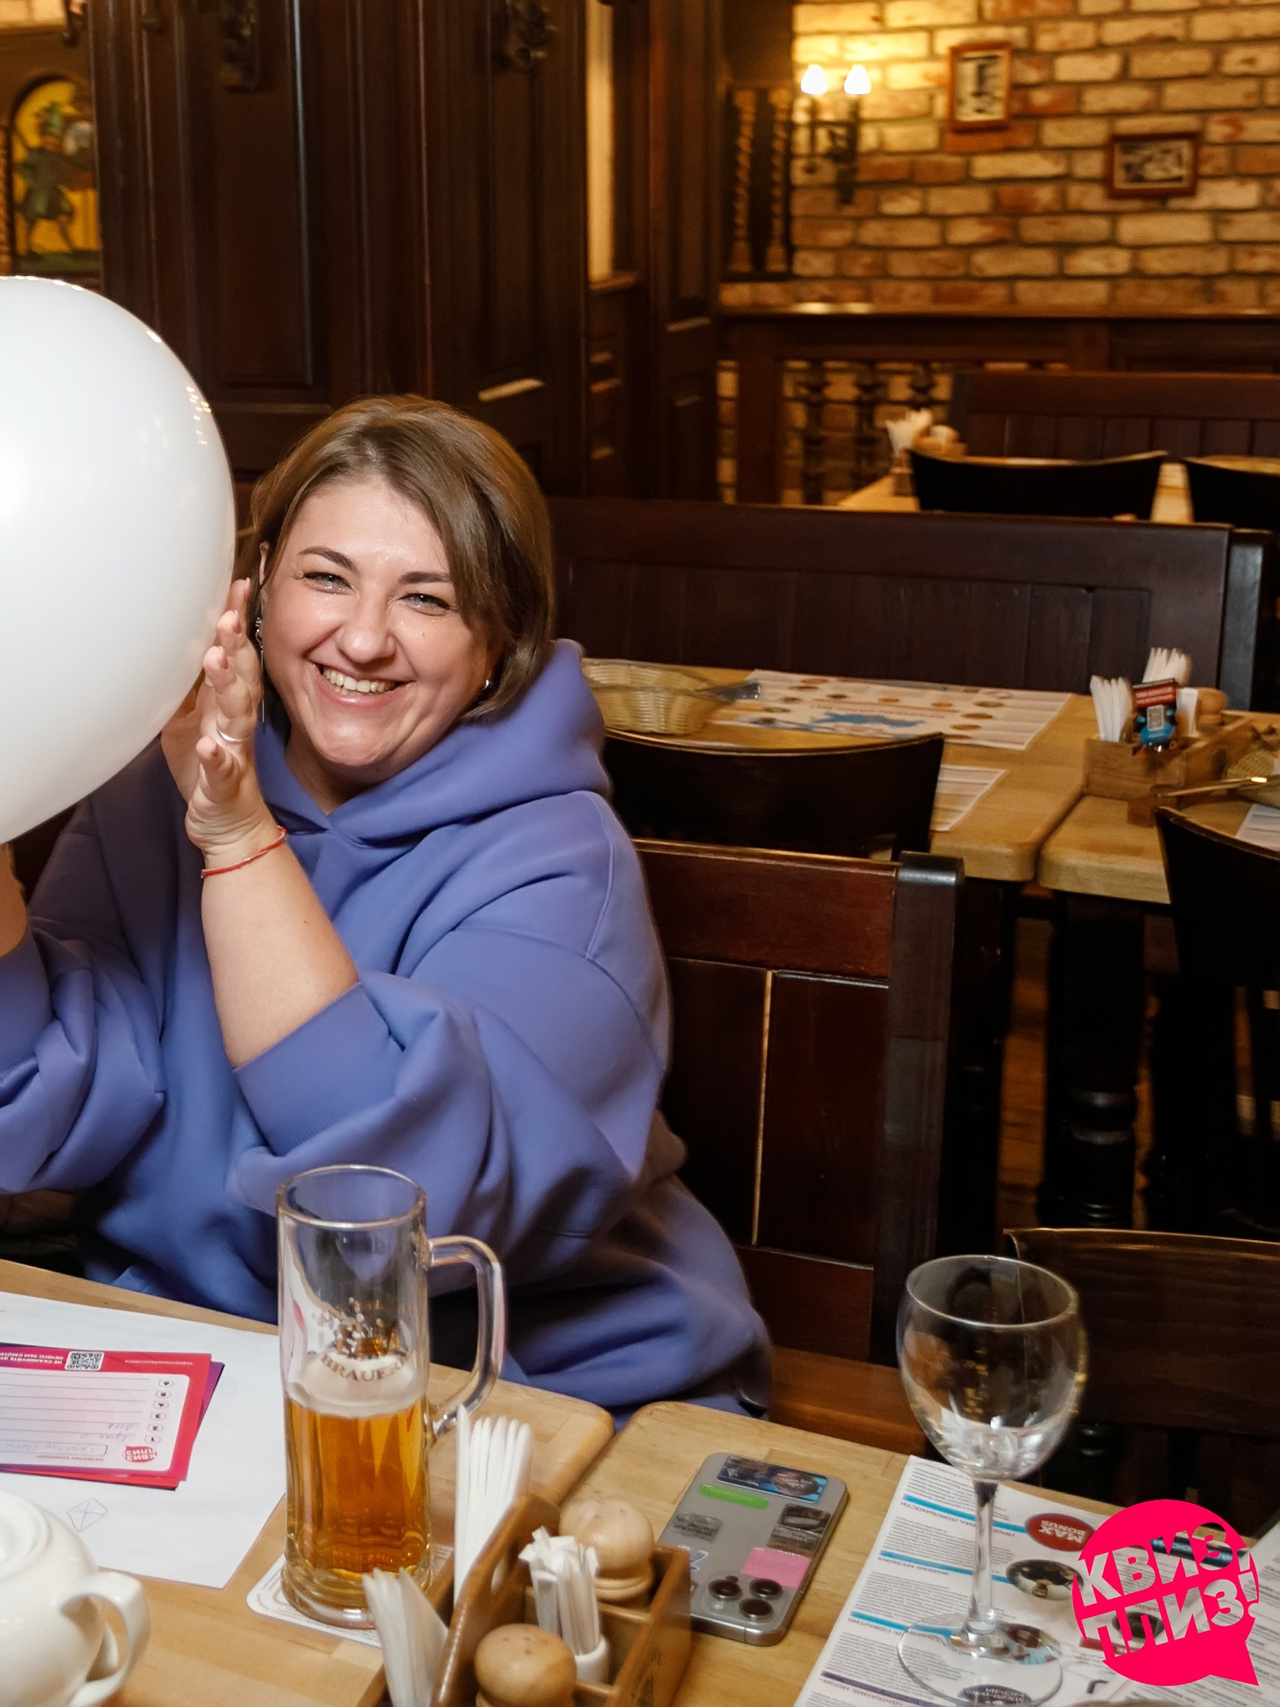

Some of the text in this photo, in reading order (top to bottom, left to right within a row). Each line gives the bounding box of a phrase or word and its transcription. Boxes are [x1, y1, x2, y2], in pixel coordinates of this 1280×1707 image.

[10, 1356, 53, 1364] СКАНИРУЙТЕ
[900, 1501, 958, 1523] ЛОЯЛЬНОСТИ
[1038, 1525, 1084, 1544] MAX
[1040, 1519, 1086, 1537] BONUS
